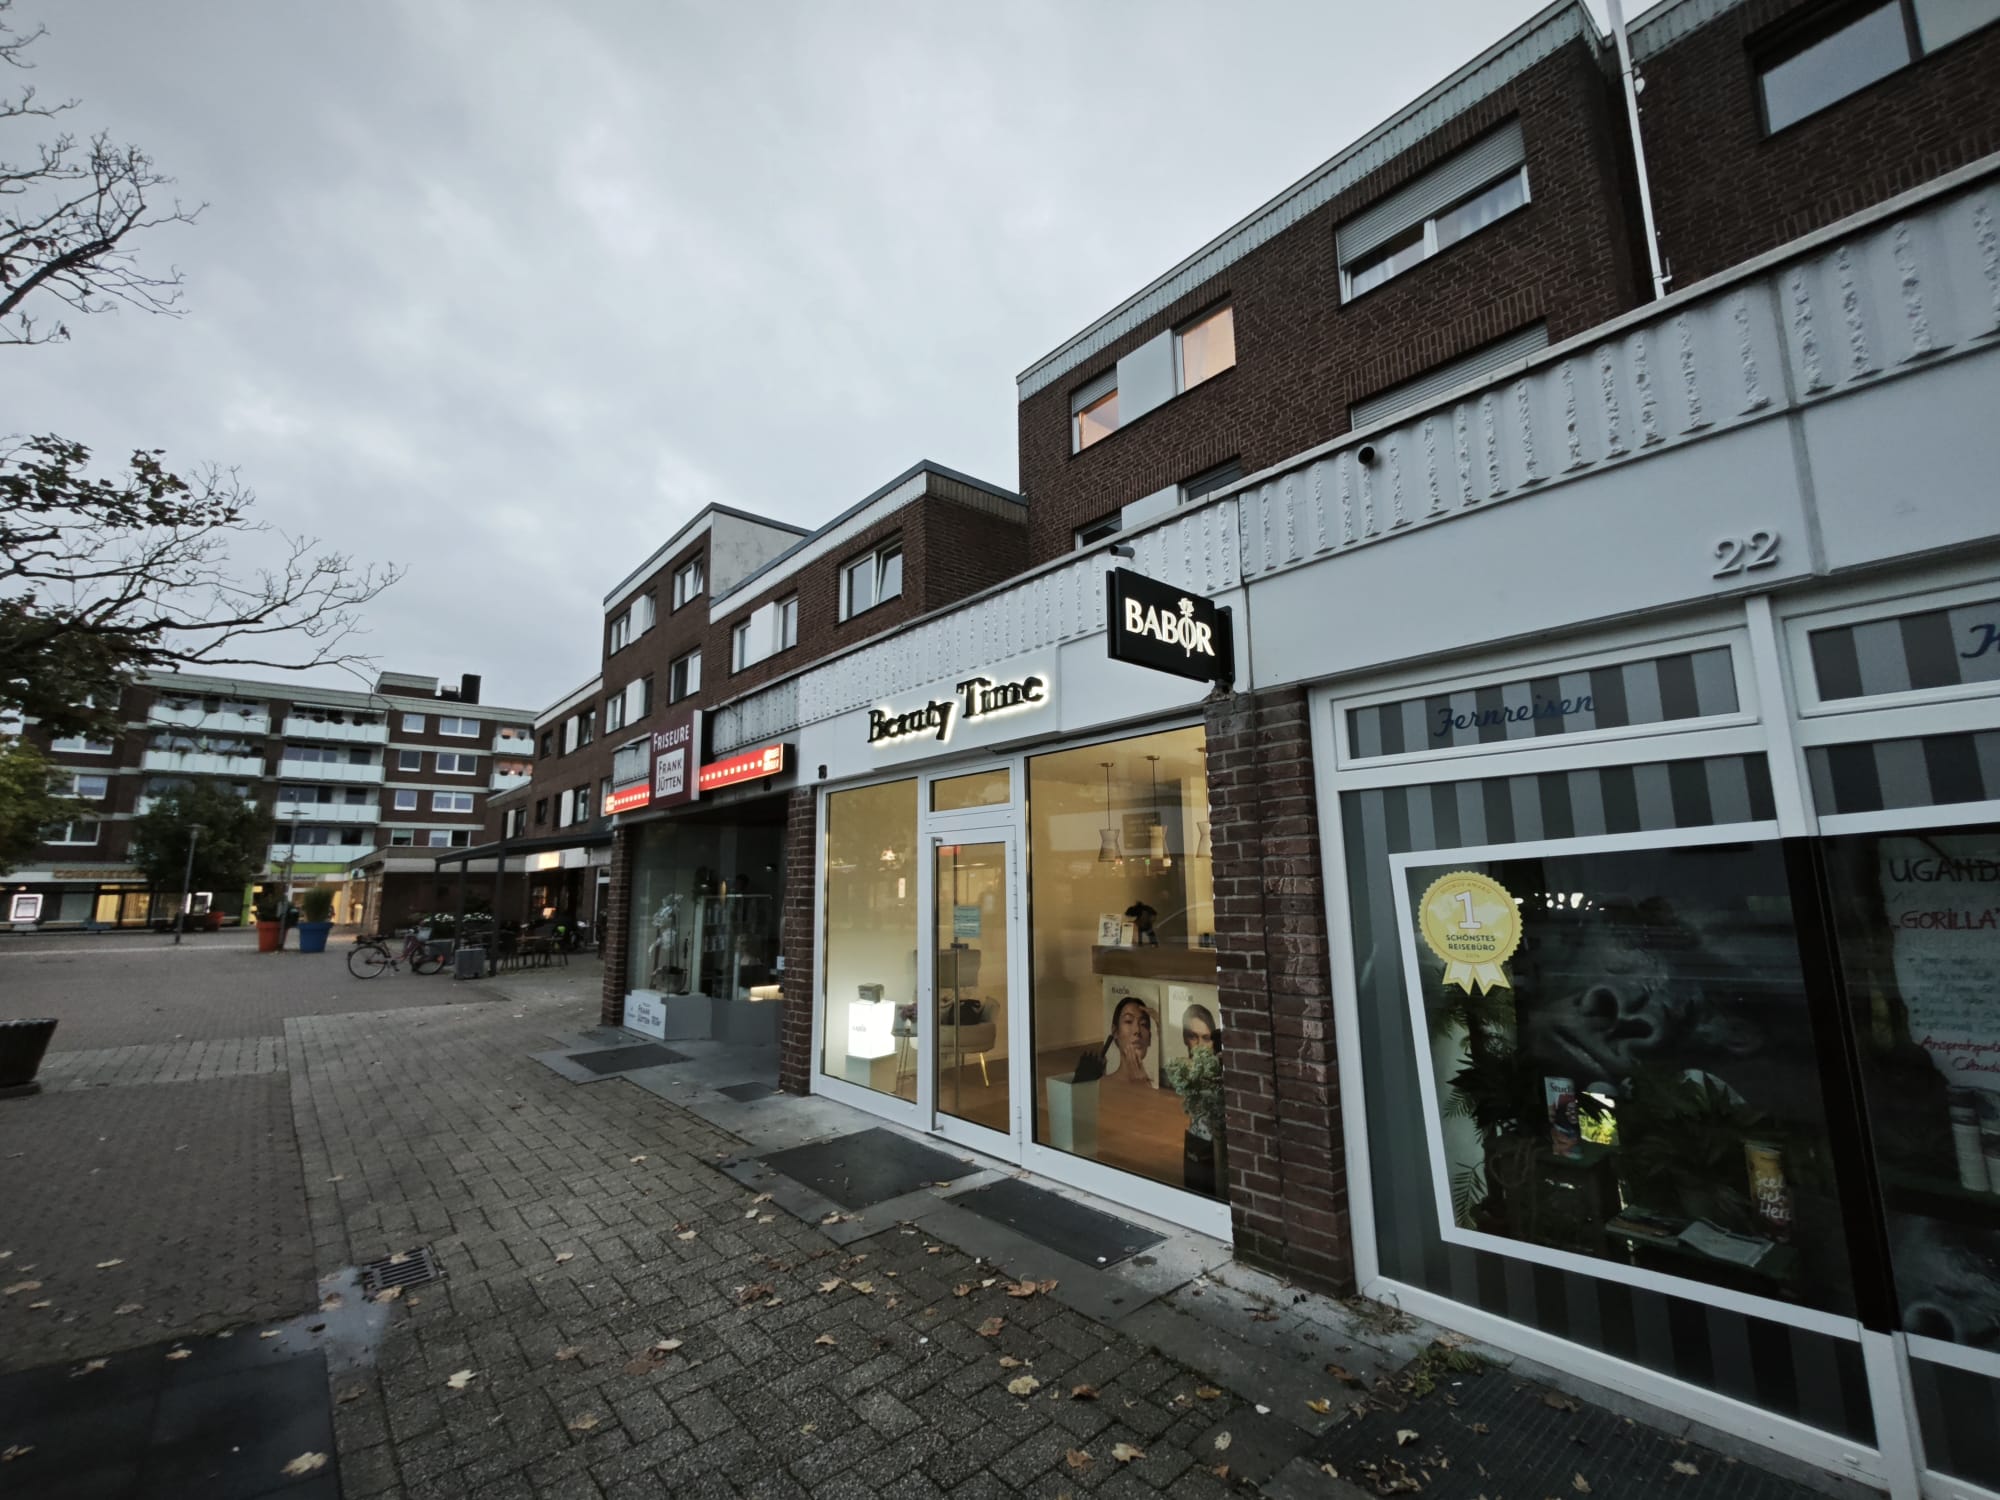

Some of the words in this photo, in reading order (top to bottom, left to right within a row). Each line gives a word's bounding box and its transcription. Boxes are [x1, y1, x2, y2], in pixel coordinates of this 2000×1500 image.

[1712, 529, 1781, 579] 22
[1125, 597, 1215, 657] BABOR
[867, 699, 955, 743] Beauty
[956, 675, 1045, 719] Time
[1433, 694, 1595, 737] Fernreisen
[653, 724, 689, 752] FRISEURE
[658, 757, 682, 774] FRANK
[657, 774, 682, 792] JÜTTEN
[1889, 857, 2000, 883] UGAND
[1455, 890, 1482, 929] 1
[1446, 933, 1496, 942] SCHÖNSTES
[1448, 942, 1496, 951] REISEBÜRO
